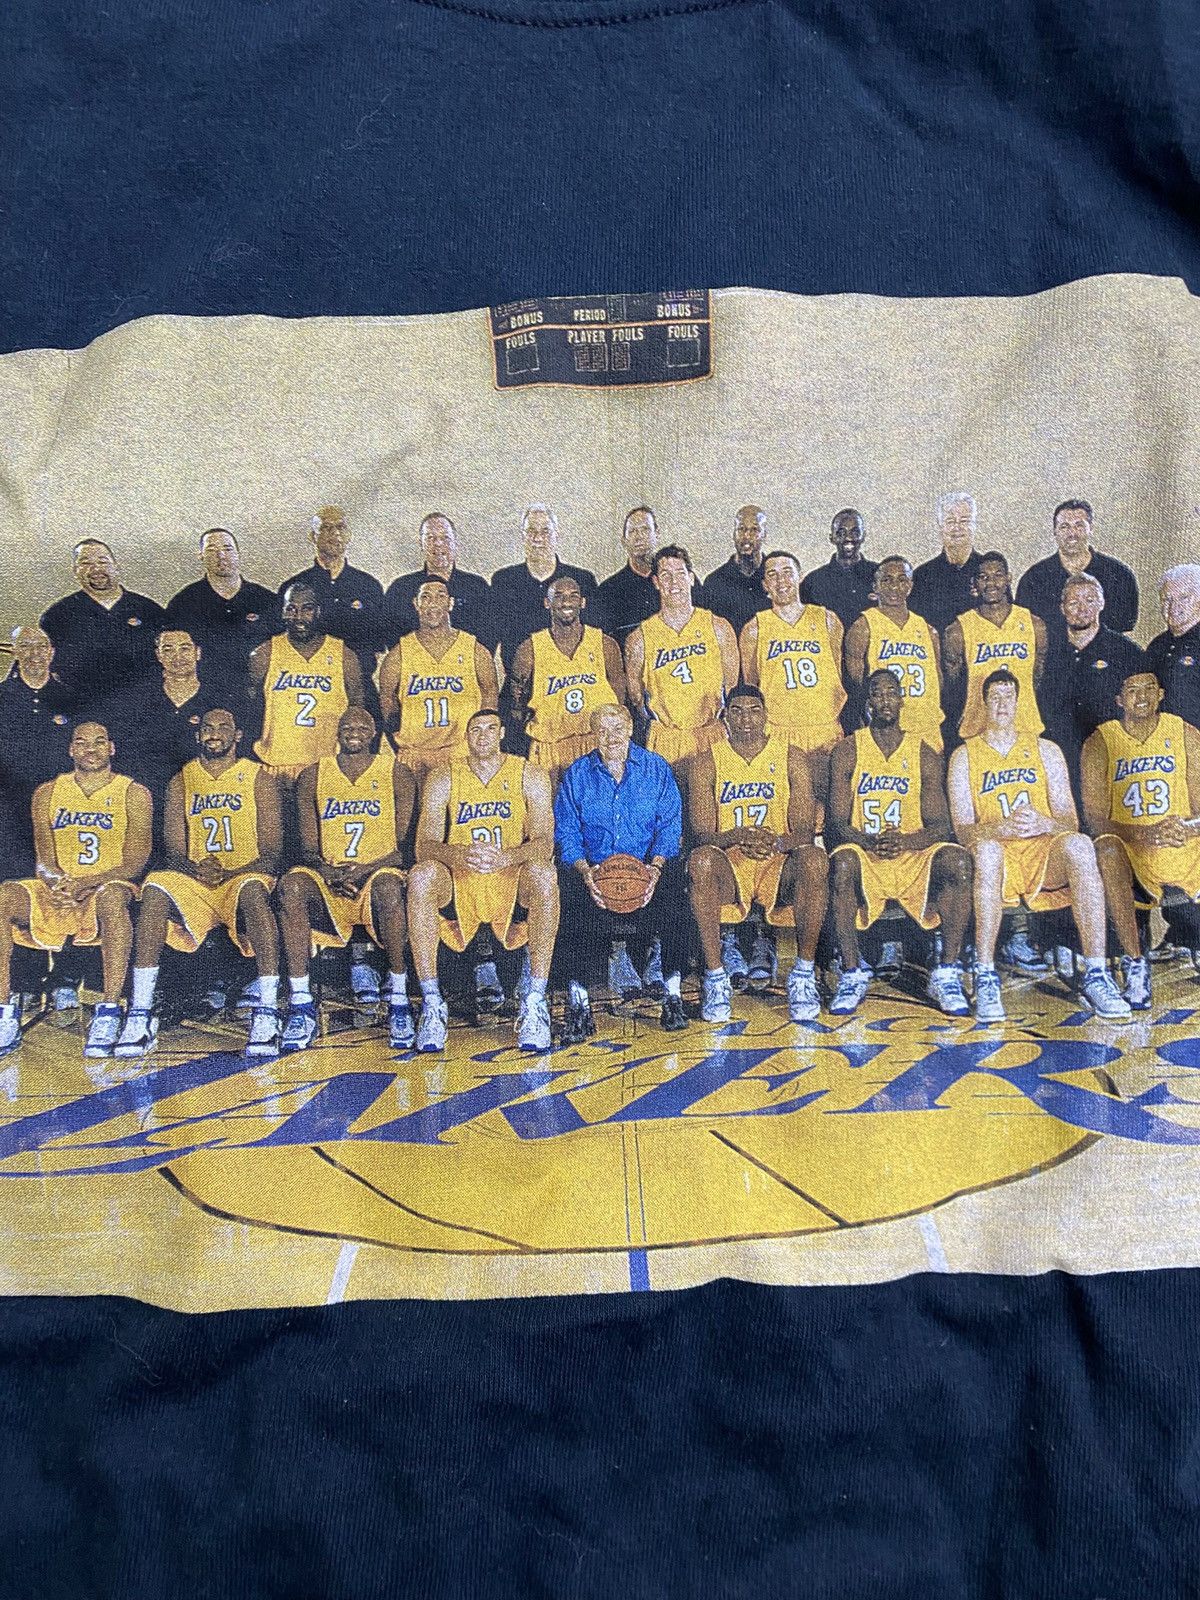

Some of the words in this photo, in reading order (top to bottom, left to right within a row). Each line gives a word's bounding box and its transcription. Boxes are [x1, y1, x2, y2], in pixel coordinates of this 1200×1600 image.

[510, 311, 544, 329] BONUS
[573, 309, 606, 322] PERIOD
[657, 303, 692, 318] BONUS
[506, 331, 536, 349] FOULS
[566, 330, 606, 344] PLAYER
[612, 328, 644, 341] FOULS
[668, 324, 699, 338] FOULS
[653, 642, 707, 670] LAKERS
[766, 639, 821, 660] LAKERS
[878, 639, 928, 660] LAKERS
[974, 643, 1028, 664] LAKERS
[272, 670, 332, 692] LAKERS
[670, 661, 694, 684] 4
[782, 657, 818, 690] 18
[407, 674, 464, 695] LAKERS
[546, 673, 598, 696] LAKERS
[295, 693, 317, 728] 2
[565, 688, 584, 714] 8
[424, 697, 449, 729] 11
[980, 767, 1037, 794] LAKERS
[1114, 756, 1175, 782] LAKERS
[720, 781, 775, 804] LAKERS
[858, 772, 909, 795] LAKERS
[189, 792, 243, 816] LAKERS
[321, 797, 381, 820] LAKERS
[1122, 779, 1170, 818] 43
[52, 807, 113, 831] LAKERS
[456, 800, 512, 825] LAKERS
[733, 803, 768, 827] 17
[862, 799, 901, 834] 54
[202, 816, 233, 853] 21
[344, 821, 365, 858] 7
[78, 831, 100, 865] 3
